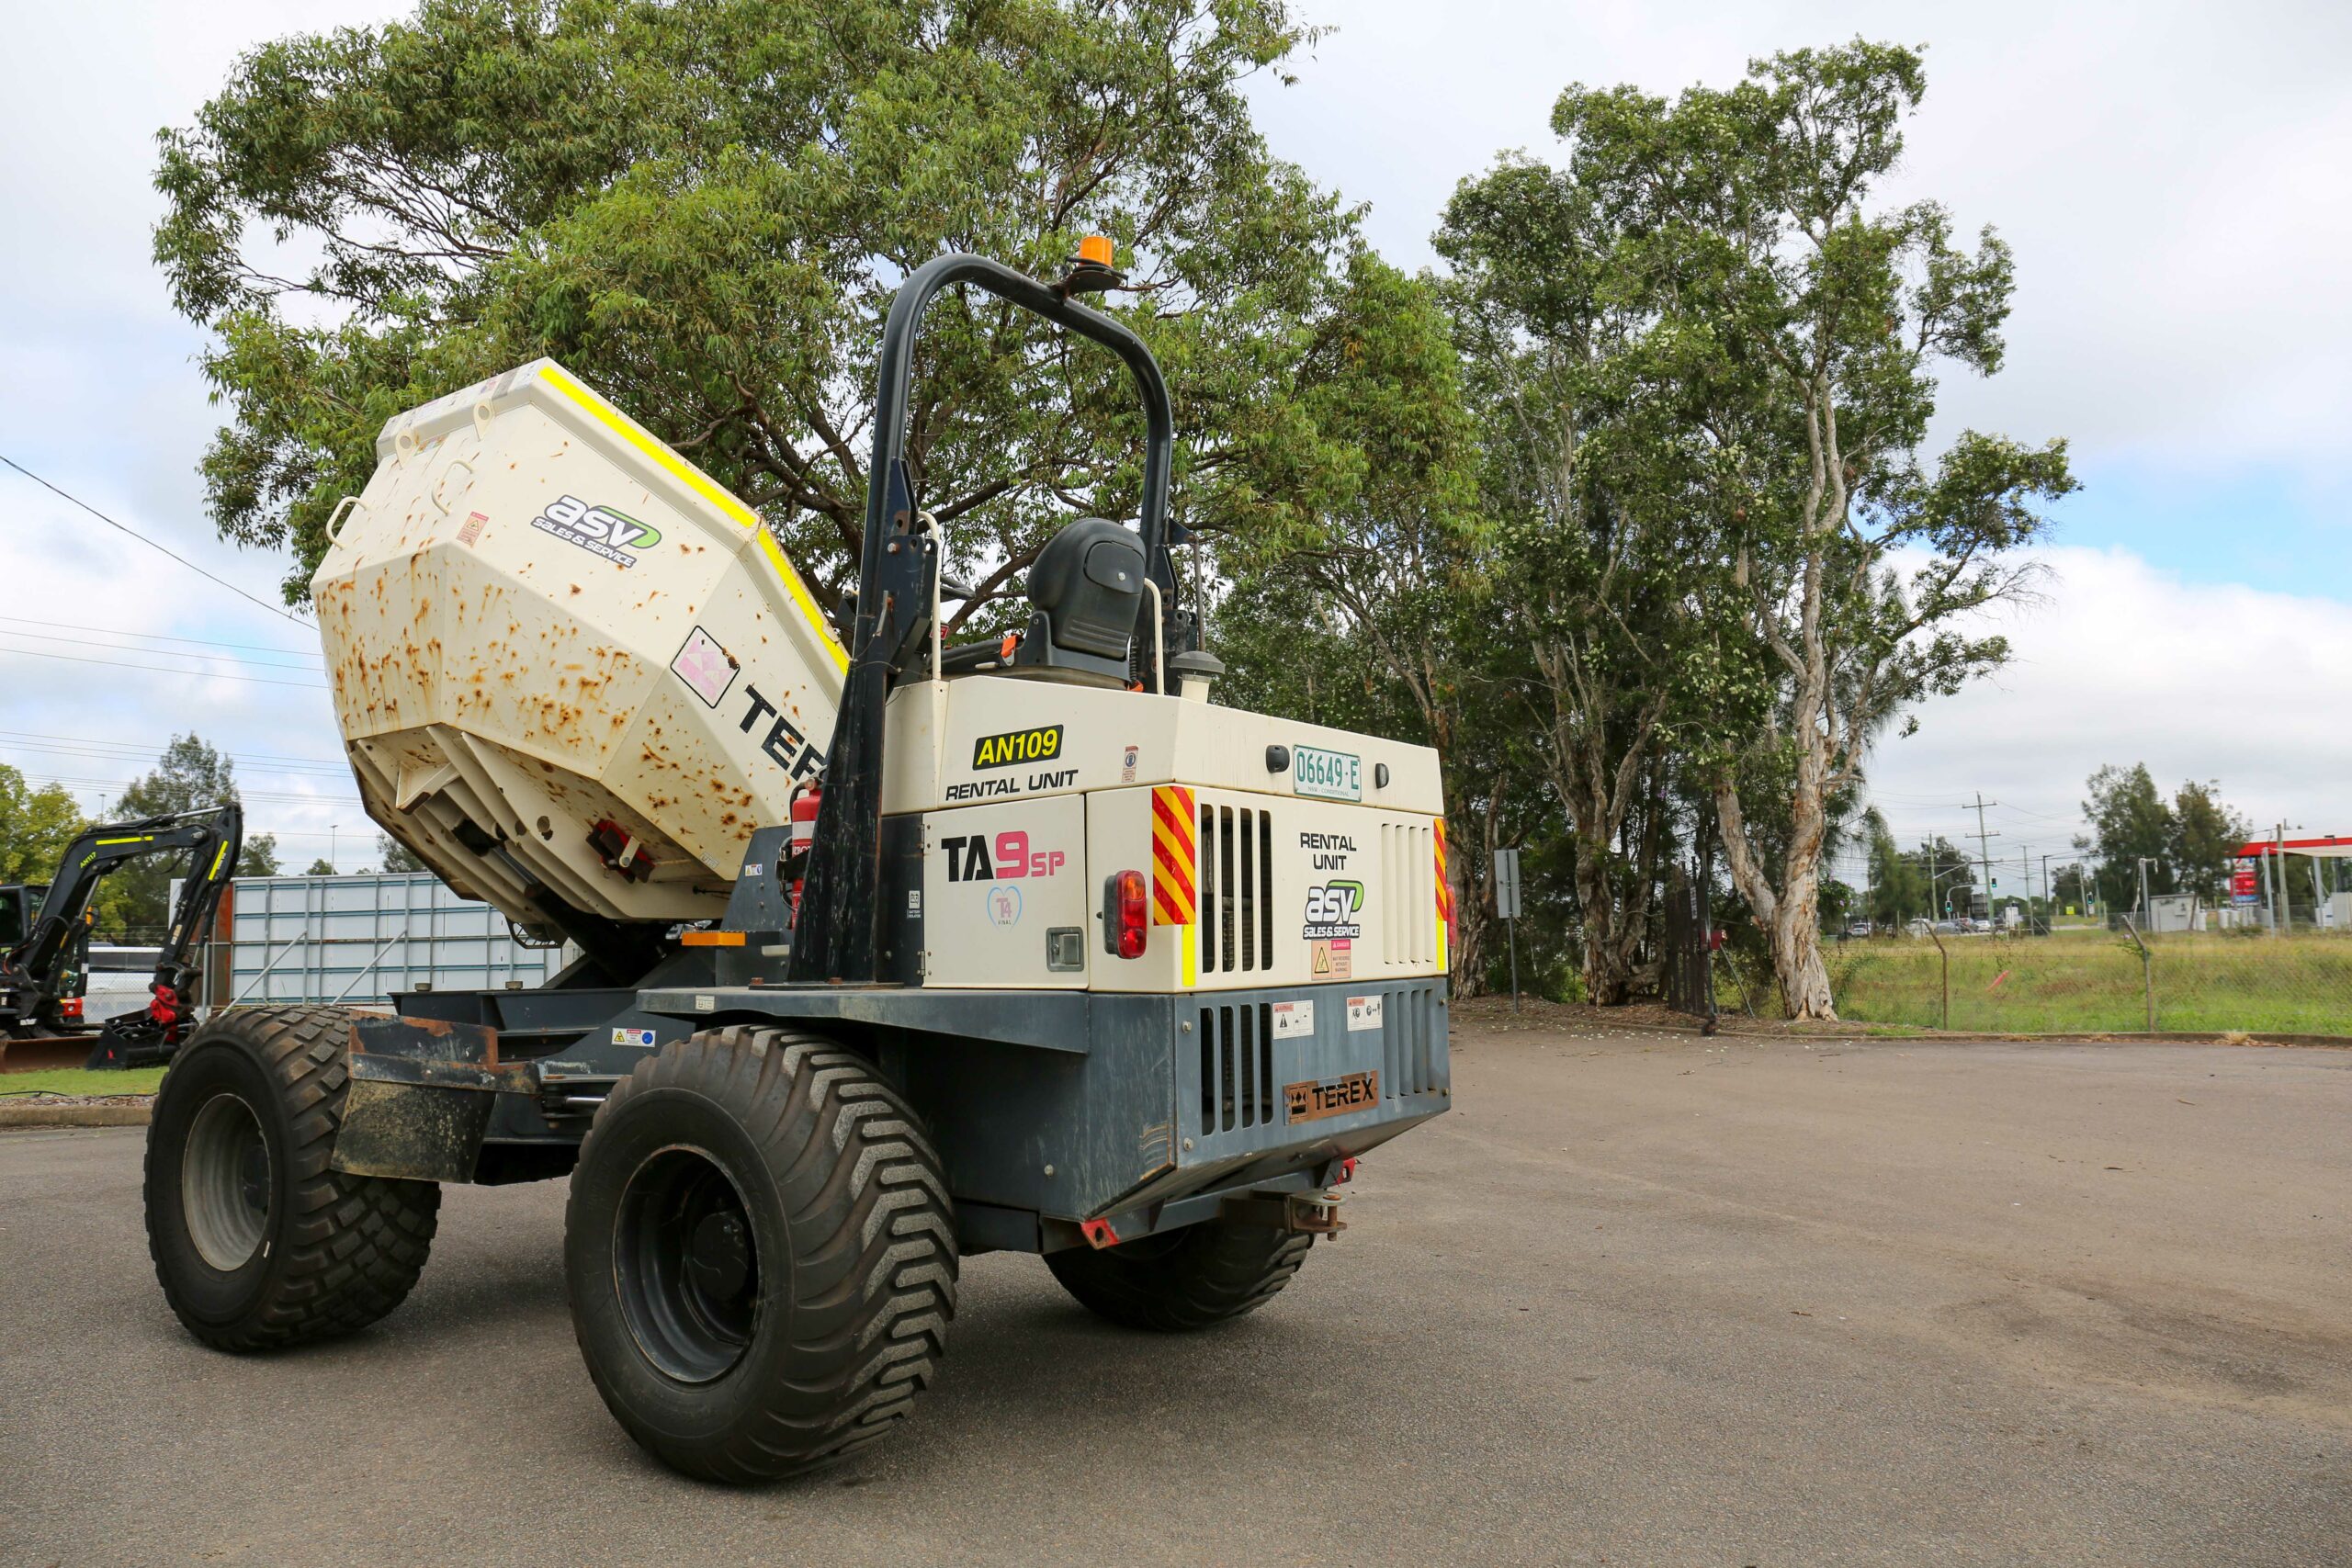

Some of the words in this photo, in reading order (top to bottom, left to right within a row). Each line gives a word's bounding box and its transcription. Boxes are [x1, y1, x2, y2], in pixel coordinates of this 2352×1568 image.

[571, 535, 584, 547] &
[584, 541, 635, 567] SERVICE
[976, 728, 1058, 765] AN109
[945, 777, 1021, 801] RENTAL
[1028, 769, 1079, 791] UNIT
[1300, 832, 1357, 852] RENTAL
[80, 851, 96, 869] AN117
[1313, 853, 1347, 870] UNIT
[1326, 926, 1334, 937] &
[1333, 926, 1360, 936] SERVICE
[1311, 1077, 1374, 1111] TEREX
